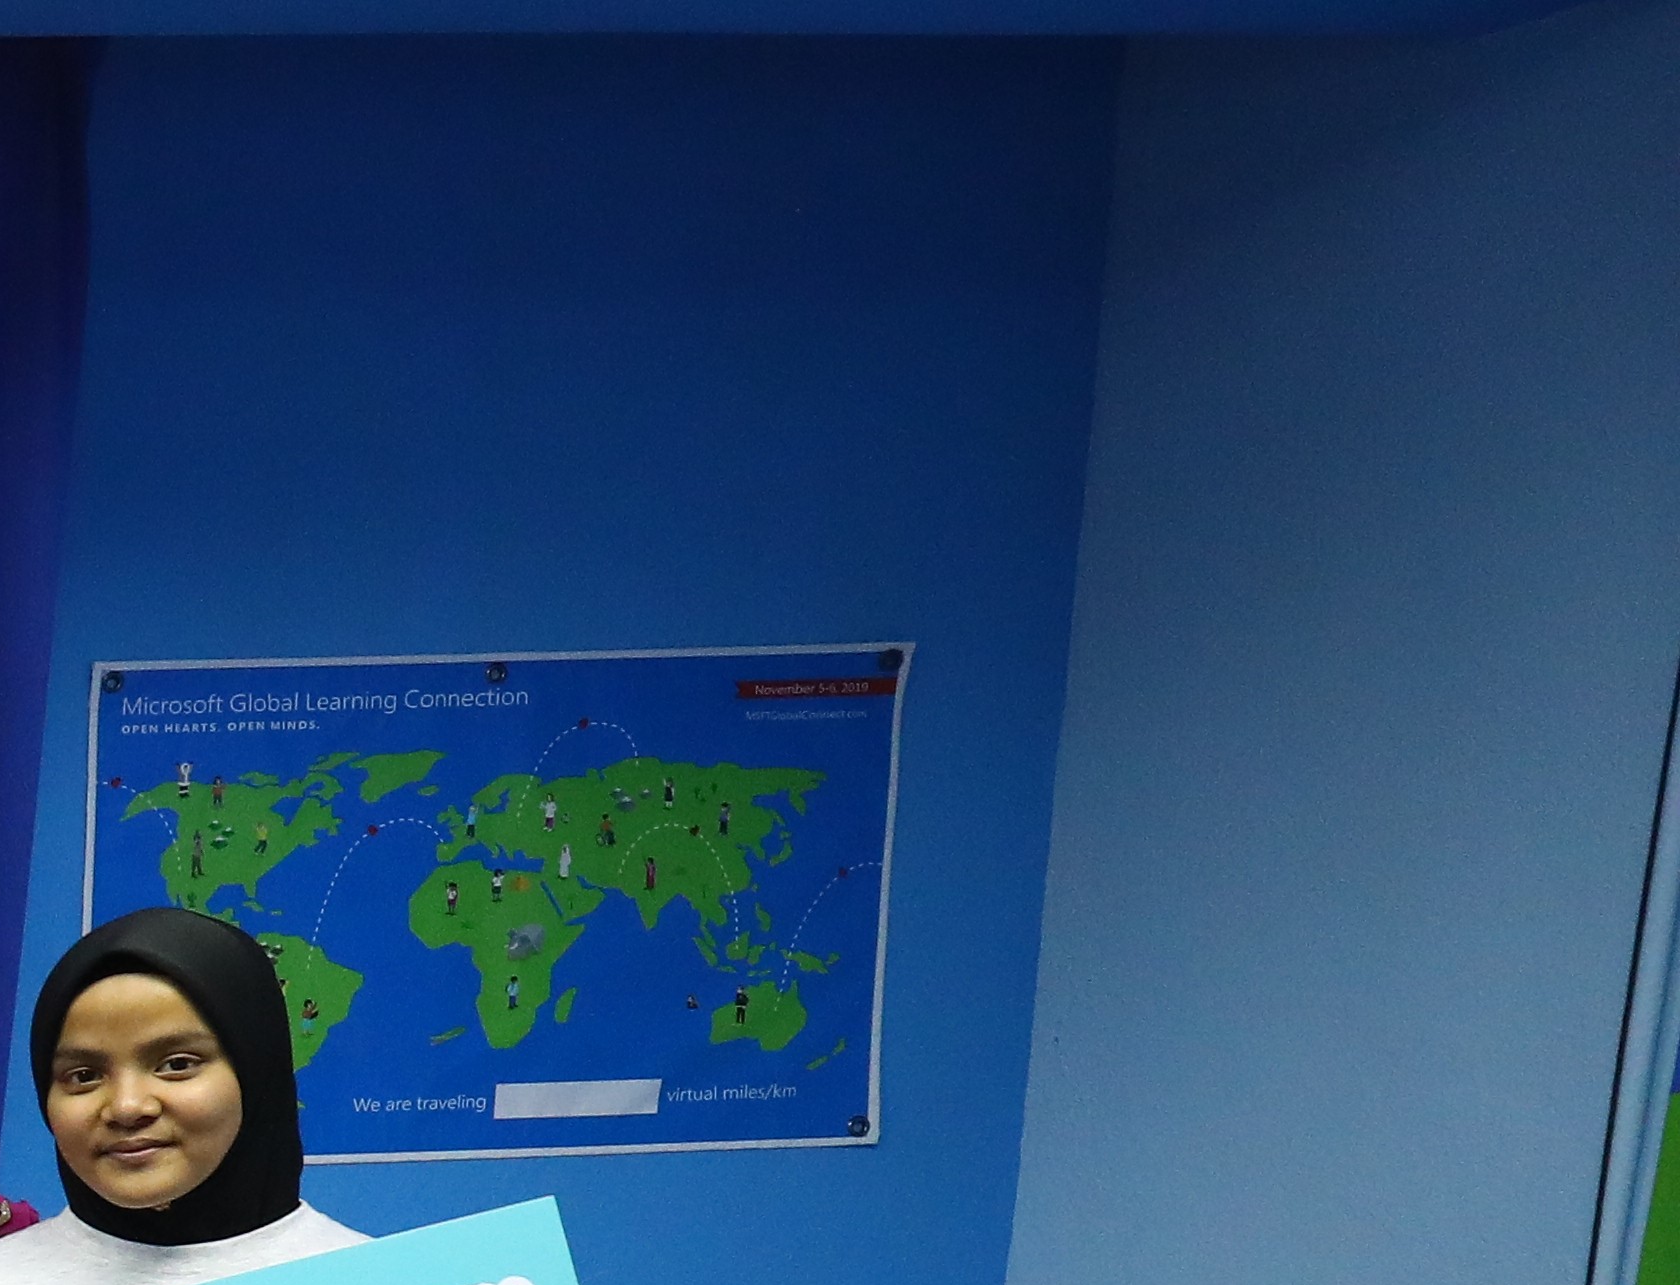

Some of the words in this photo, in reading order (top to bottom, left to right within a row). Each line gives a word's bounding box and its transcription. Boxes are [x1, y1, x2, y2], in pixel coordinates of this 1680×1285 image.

[755, 683, 814, 695] November
[841, 681, 869, 693] 2019
[122, 693, 223, 716] Microsoft
[230, 692, 299, 714] Global
[306, 690, 396, 716] Learning
[404, 687, 529, 709] Connection
[121, 724, 158, 734] OPEN
[164, 723, 220, 733] HEARTS.
[227, 722, 265, 732] OPEN
[270, 720, 320, 731] MINDS.
[353, 1097, 380, 1112] We
[385, 1099, 411, 1112] are
[416, 1094, 486, 1113] traveling
[667, 1086, 717, 1102] virtual
[723, 1083, 797, 1101] miles/km
